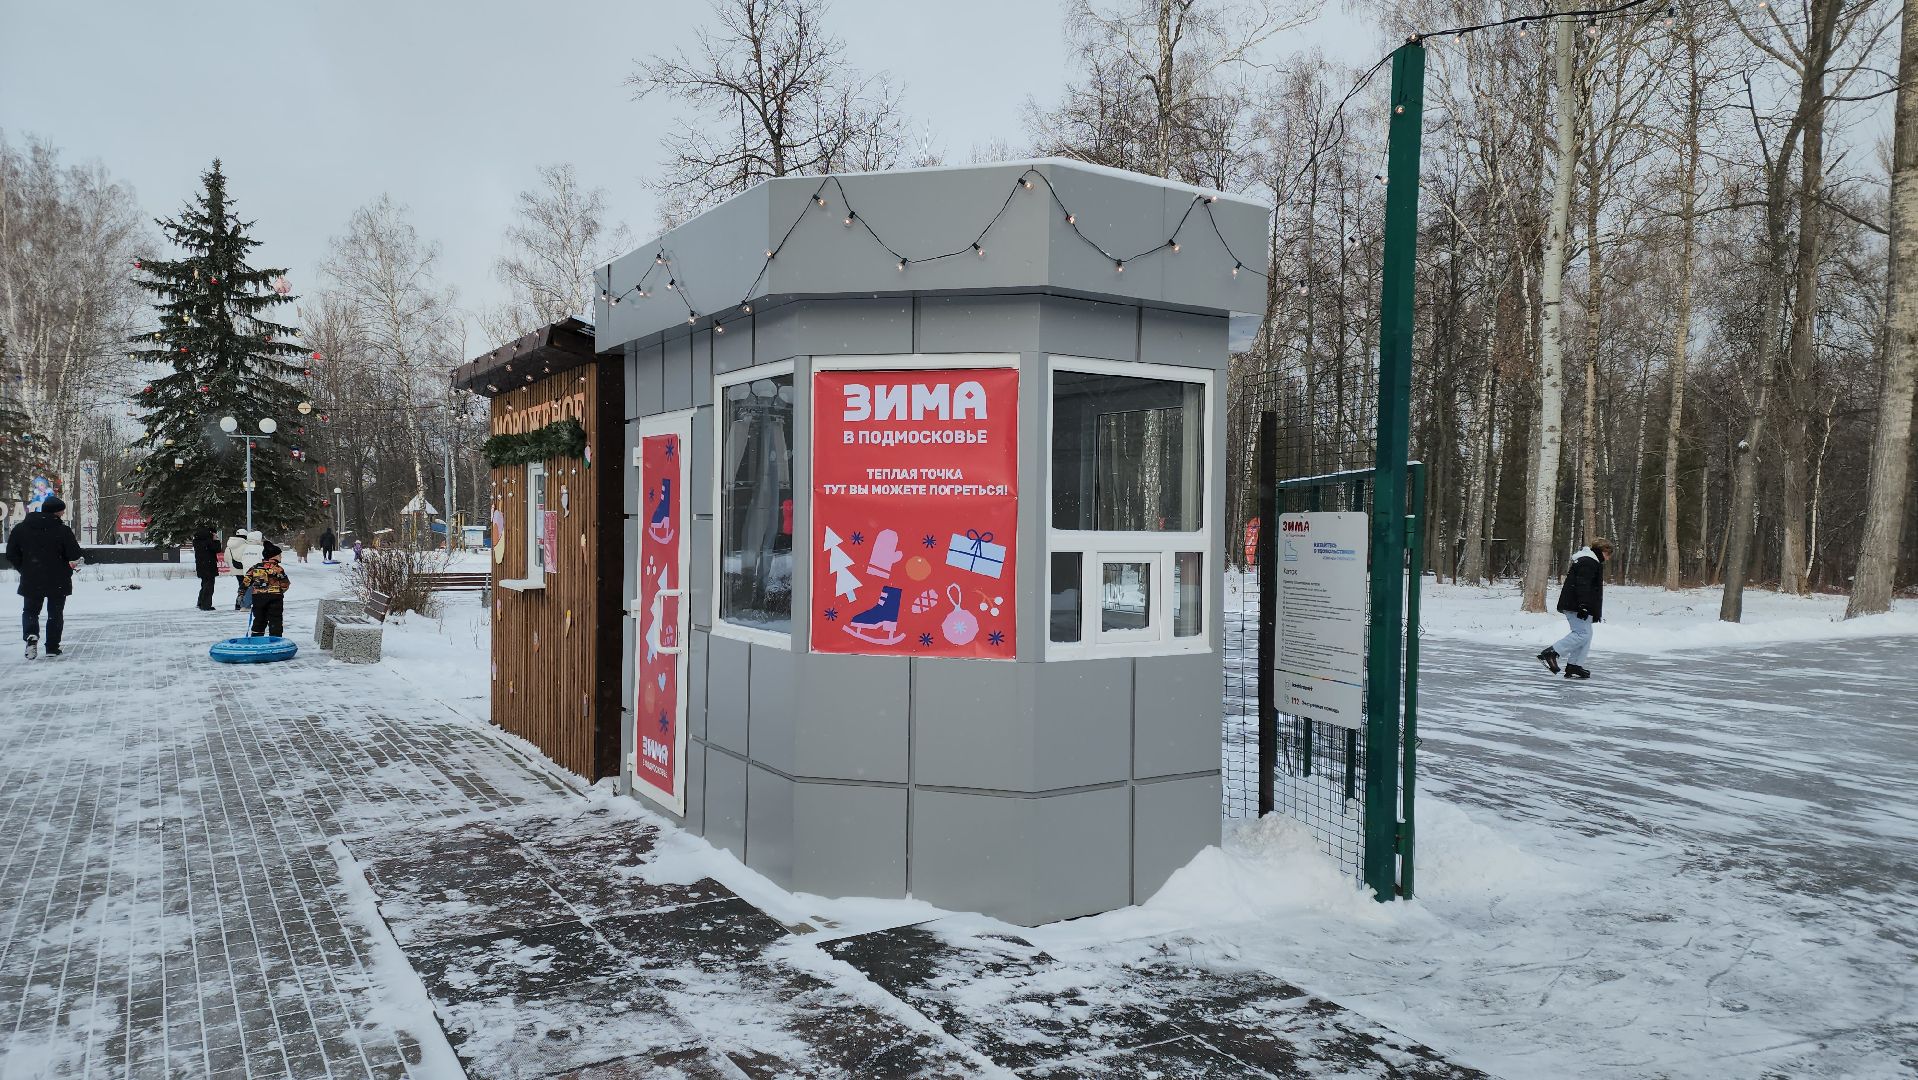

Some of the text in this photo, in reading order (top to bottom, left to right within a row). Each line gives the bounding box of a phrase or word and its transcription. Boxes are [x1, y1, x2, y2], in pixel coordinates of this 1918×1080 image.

[843, 380, 988, 422] ЗИМА
[843, 429, 988, 447] В ПОДМОСКОВЬЕ
[866, 468, 963, 480] ТЕПЛАЯ ТОЧКА
[823, 484, 1008, 496] ТУТ ВЫ МОЖЕТЕ ПОГРЕТЬСЯ!
[1282, 520, 1310, 532] ЗИМА
[642, 735, 669, 767] ЗИМА
